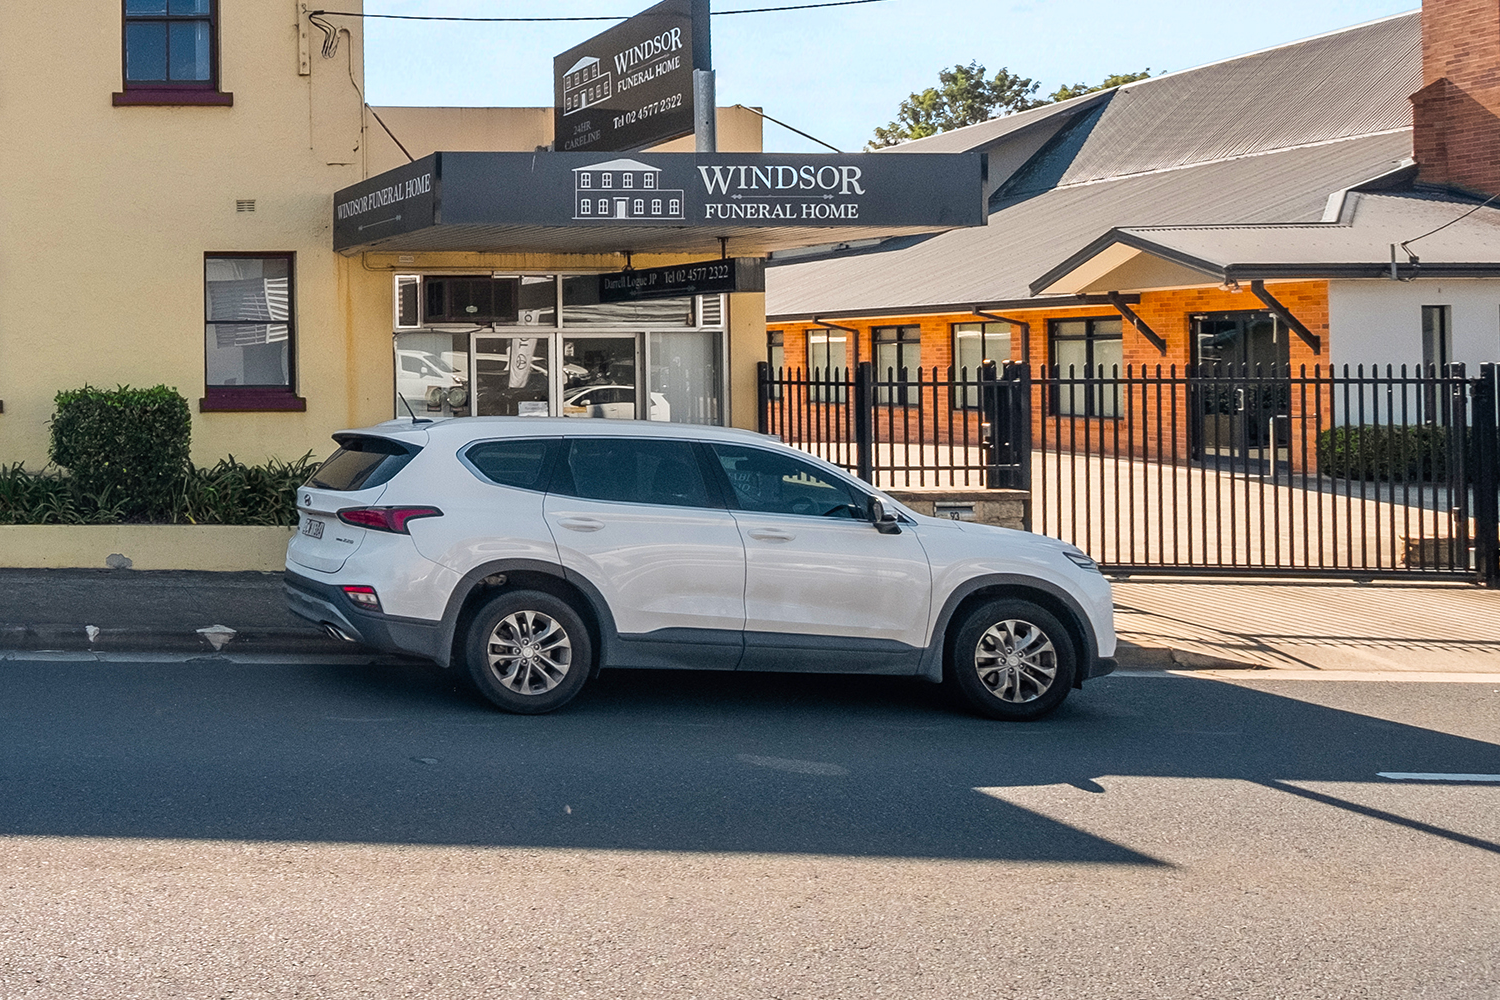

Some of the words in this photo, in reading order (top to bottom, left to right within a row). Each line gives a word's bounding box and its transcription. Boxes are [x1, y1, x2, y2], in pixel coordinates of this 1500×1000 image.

[614, 27, 683, 75] WINDSOR
[617, 68, 655, 93] FUNERAL
[655, 56, 681, 77] HOME
[613, 115, 624, 129] Tel
[625, 110, 636, 124] 02
[637, 101, 659, 120] 4577
[660, 93, 682, 113] 2322
[564, 129, 601, 150] CARELINE
[697, 165, 866, 195] WINDSOR
[337, 195, 369, 220] WINDSOR
[368, 182, 405, 211] FUNERAL
[405, 173, 431, 199] HOME
[704, 203, 797, 219] FUNERAL
[800, 203, 859, 219] HOME
[626, 275, 648, 290] Logue
[648, 272, 658, 285] JP
[663, 270, 675, 283] Tel
[676, 269, 686, 282] 02
[687, 267, 707, 281] 4577
[708, 264, 729, 280] 2322
[950, 511, 960, 521] 93
